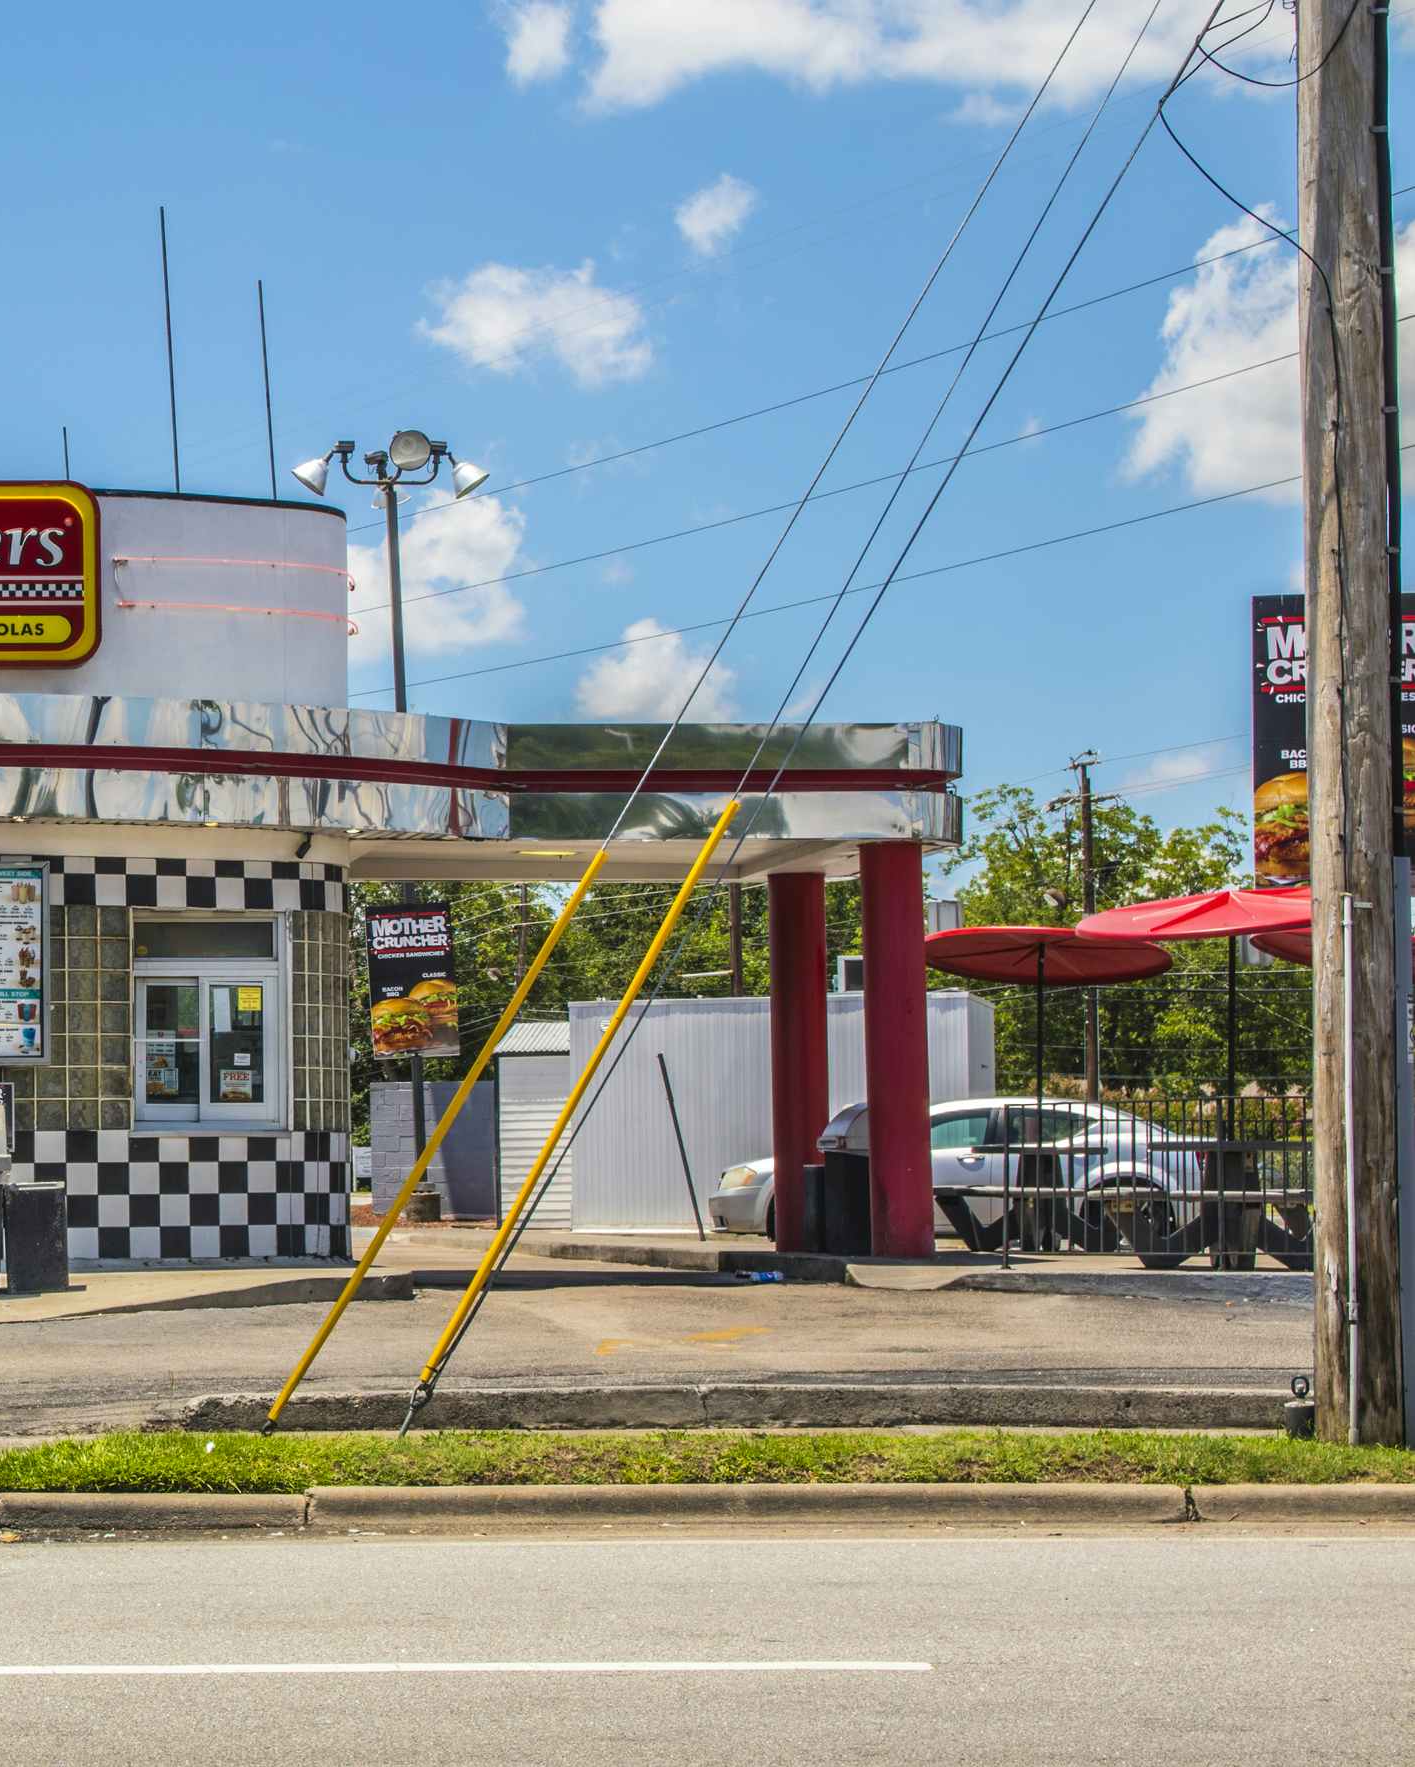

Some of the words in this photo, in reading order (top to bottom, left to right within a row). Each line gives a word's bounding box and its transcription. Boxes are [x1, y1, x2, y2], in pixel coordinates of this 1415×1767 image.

[1275, 693, 1306, 704] CHIC
[1281, 749, 1306, 760] BAC
[1289, 759, 1306, 770] BB
[372, 916, 446, 937] MOTHER
[373, 934, 447, 949] CRUNCHER
[223, 1072, 250, 1081] FREE
